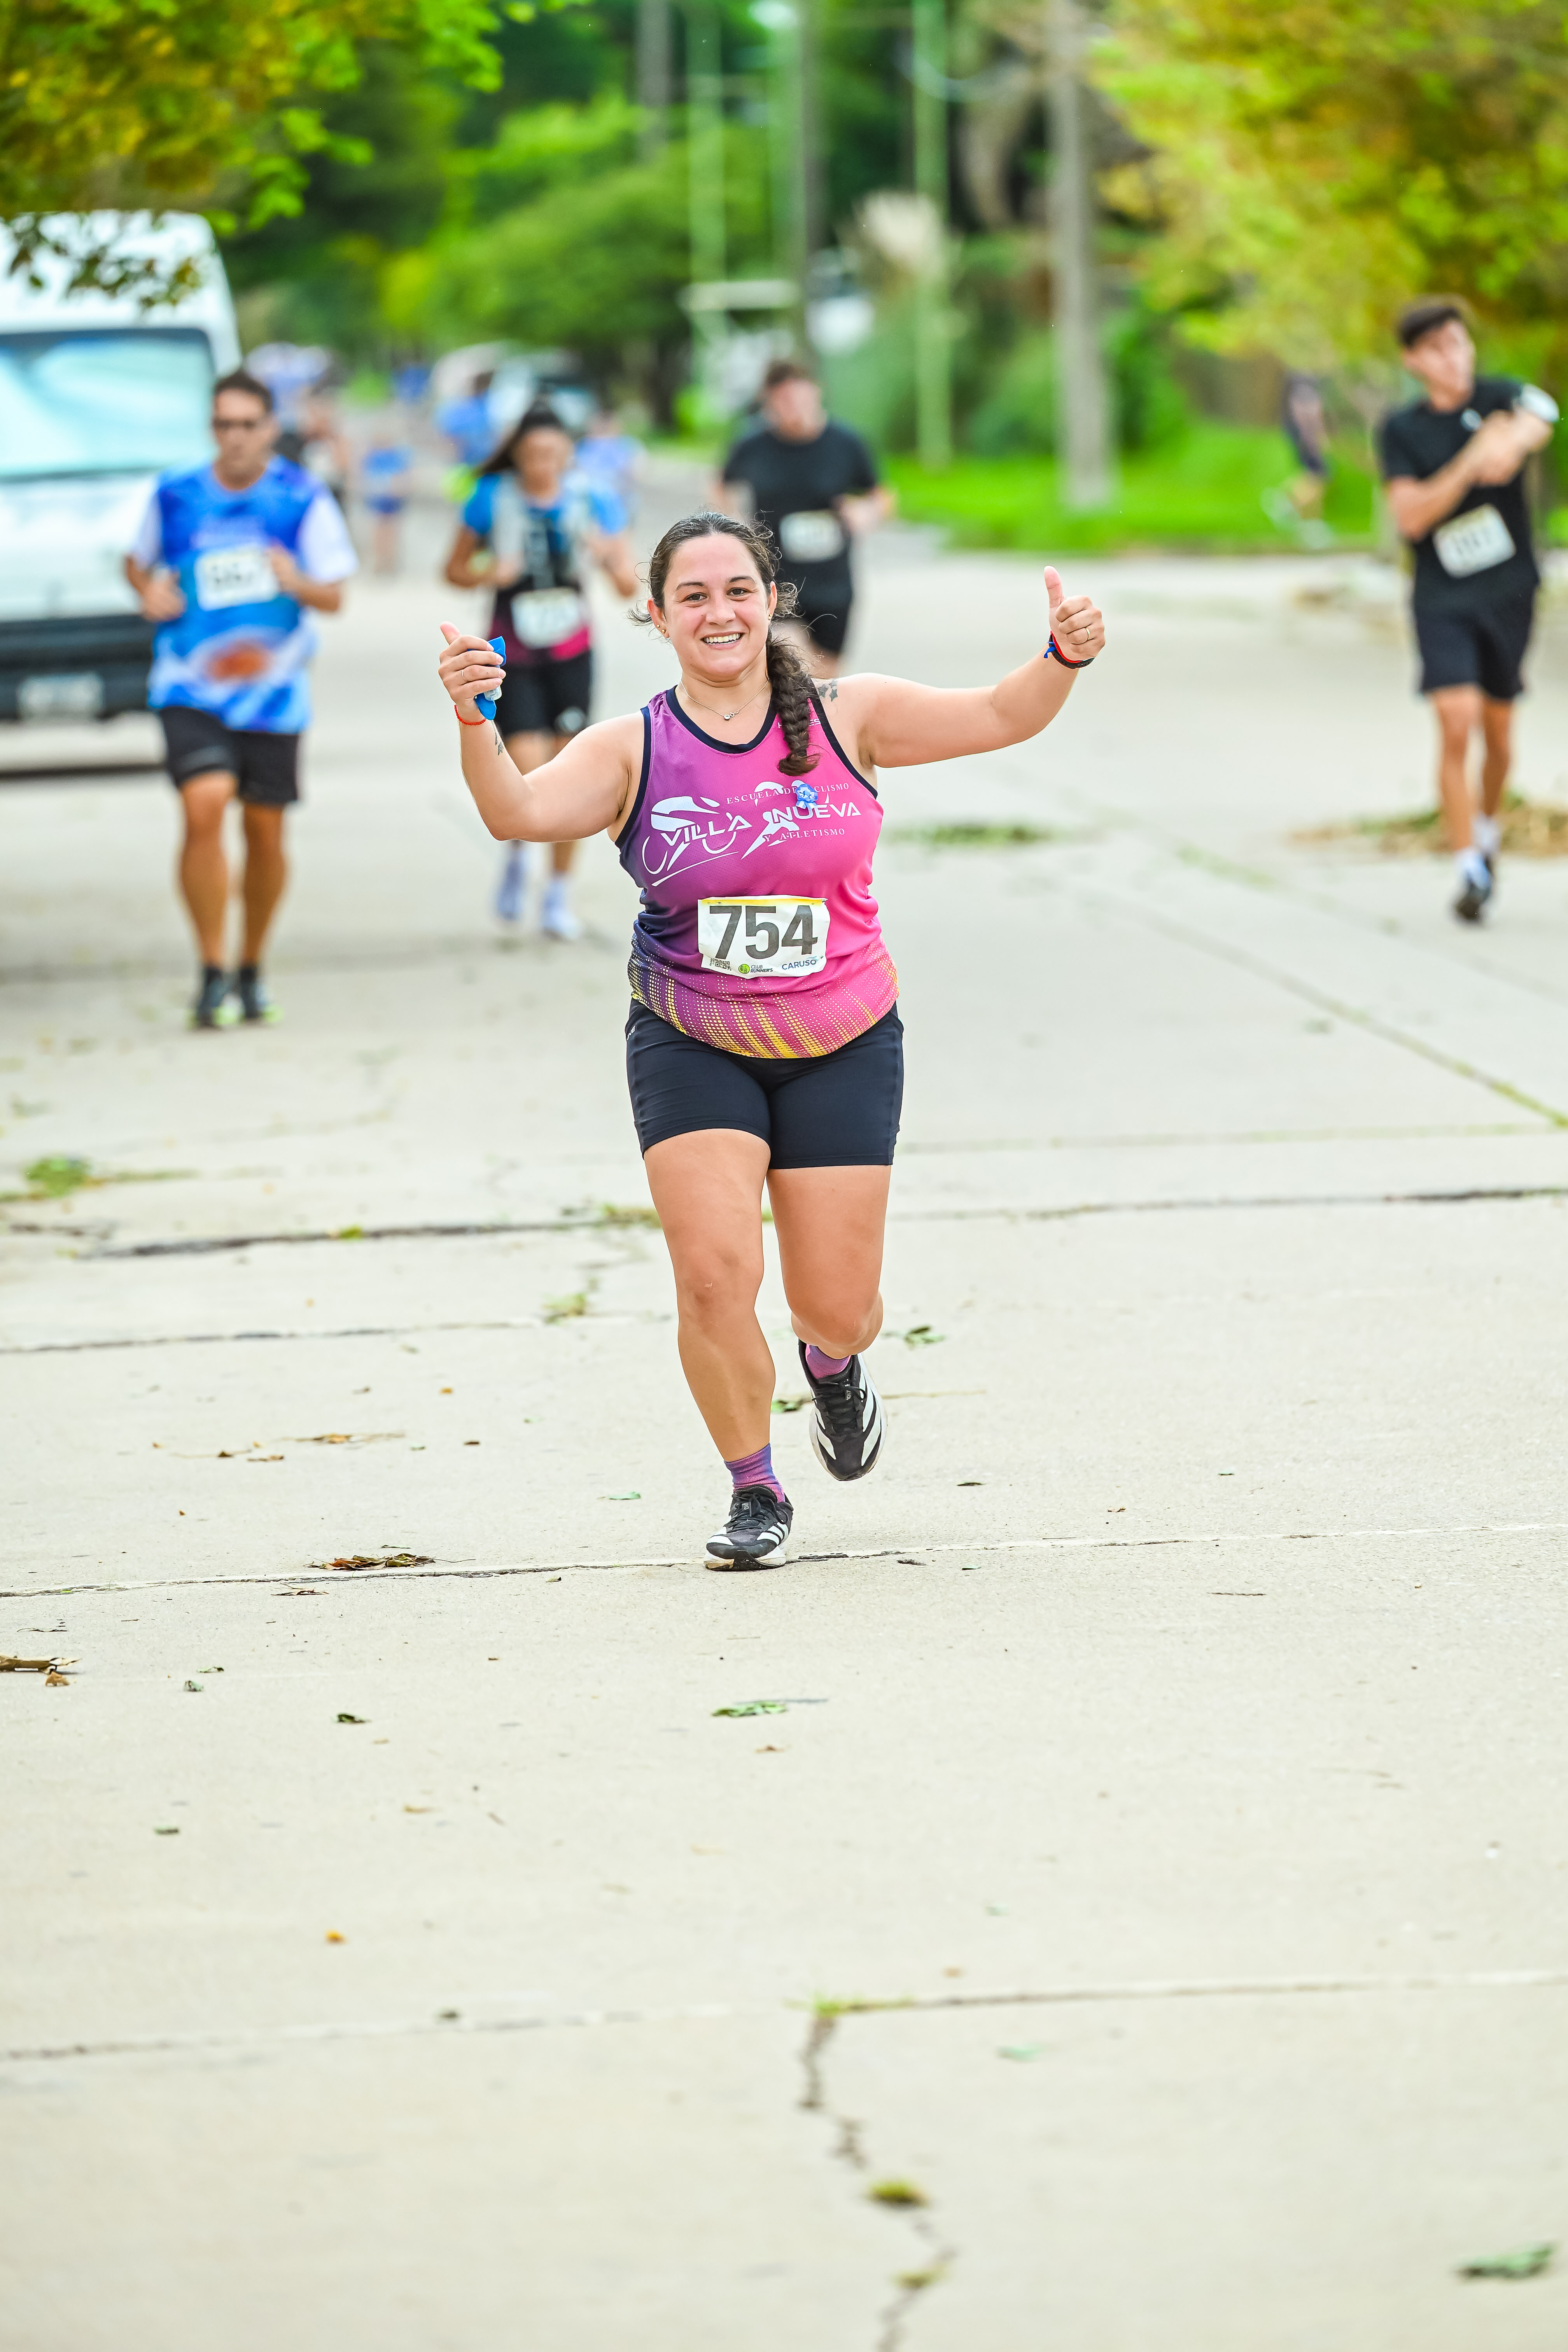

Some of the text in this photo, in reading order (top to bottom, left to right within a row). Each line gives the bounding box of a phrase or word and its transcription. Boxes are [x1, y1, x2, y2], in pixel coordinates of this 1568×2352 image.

[726, 790, 780, 805] ESCUELA
[814, 783, 849, 793] CLISMO
[660, 802, 862, 846] VILLA NUEVA
[780, 828, 845, 840] ATLETISMO
[709, 905, 818, 959] 754
[782, 959, 817, 970] CARUSO
